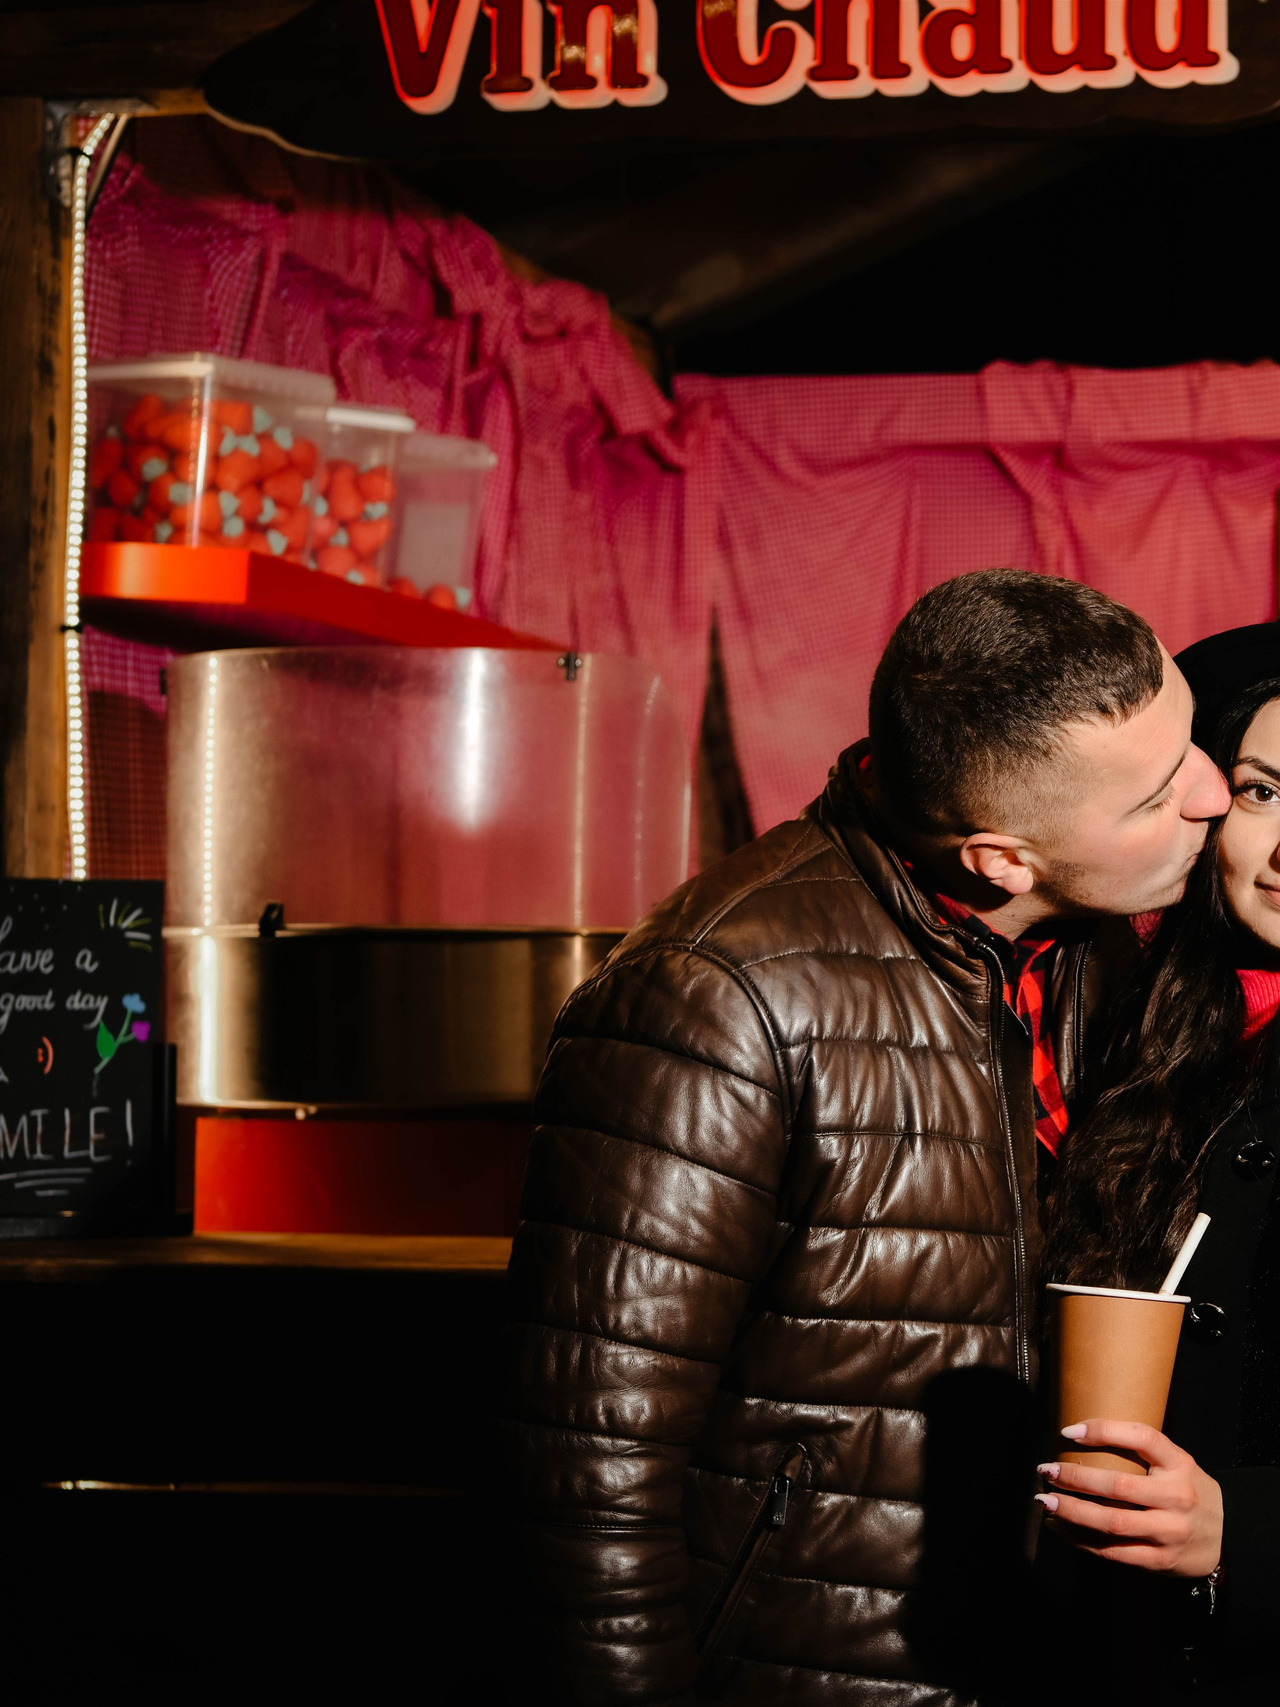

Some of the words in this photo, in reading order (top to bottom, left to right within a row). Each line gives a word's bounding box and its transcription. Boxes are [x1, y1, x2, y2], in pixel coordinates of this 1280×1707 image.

[376, 0, 669, 116] Vin
[76, 948, 100, 974] a
[0, 989, 55, 1034] good
[66, 988, 109, 1030] day
